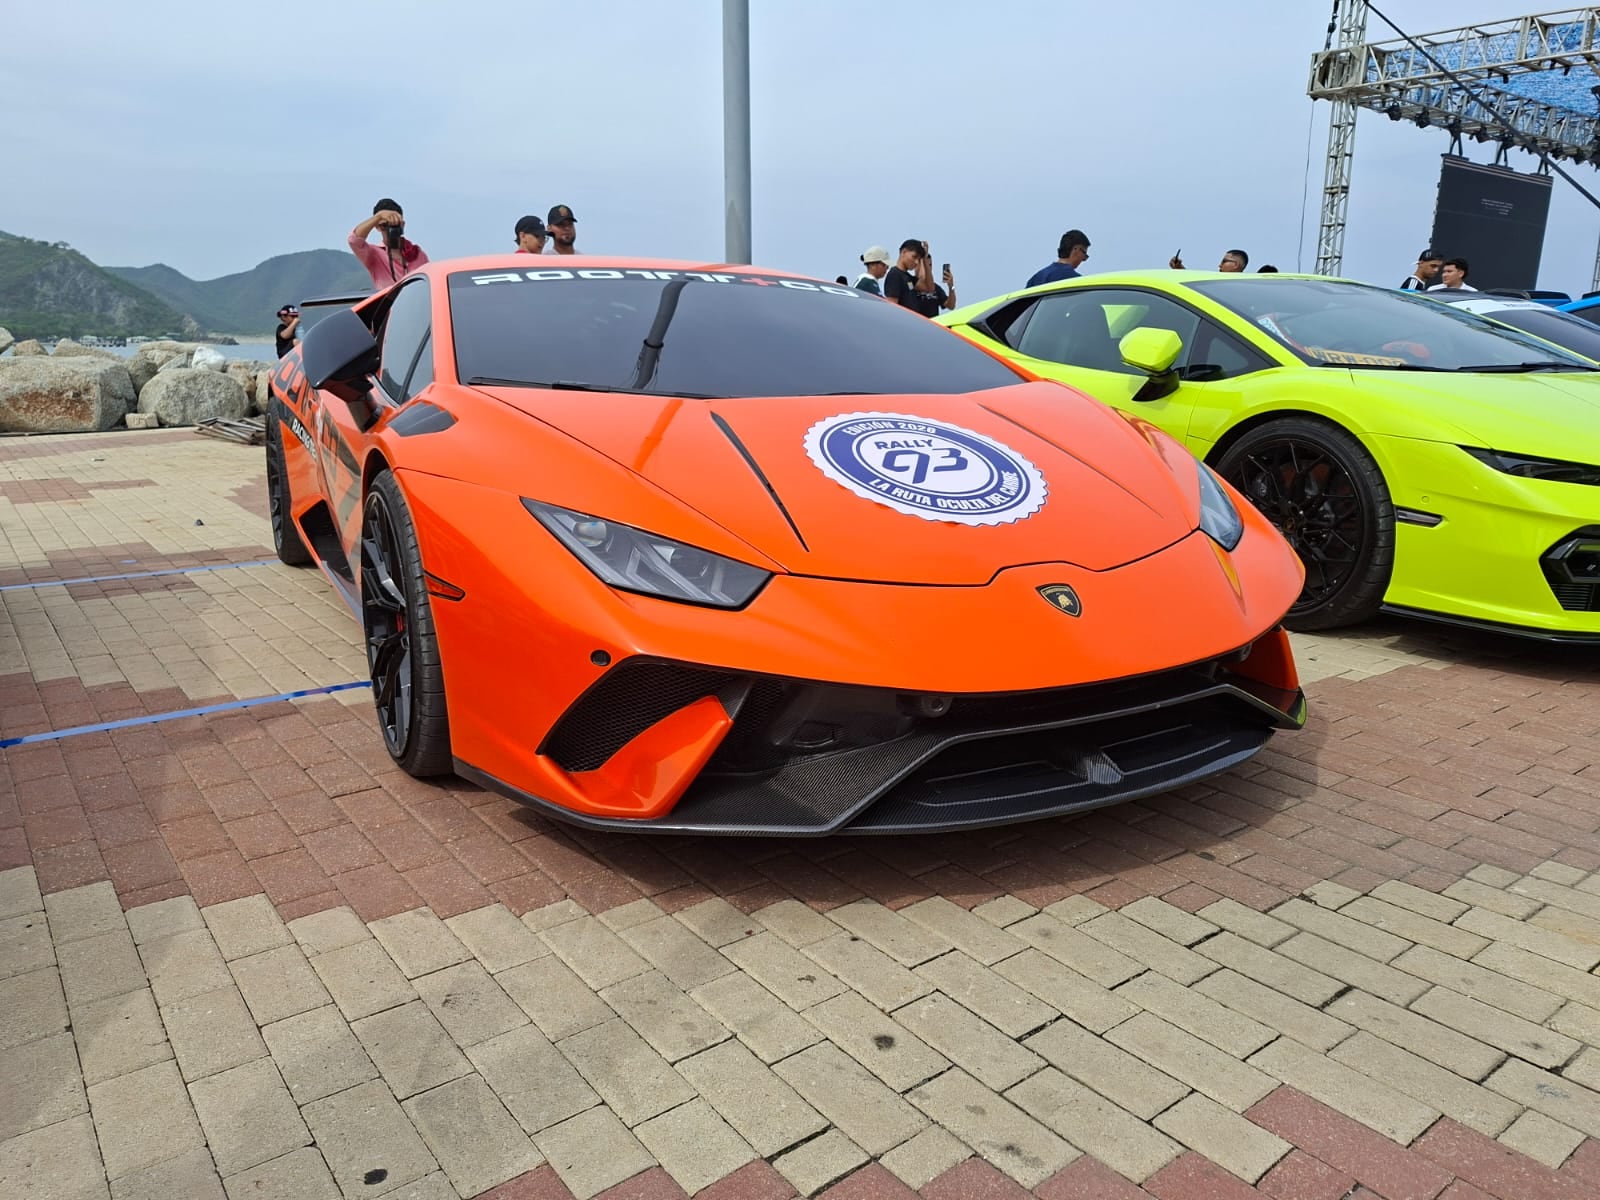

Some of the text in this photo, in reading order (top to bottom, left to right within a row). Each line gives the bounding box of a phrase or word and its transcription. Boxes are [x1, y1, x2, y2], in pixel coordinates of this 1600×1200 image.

[842, 420, 895, 436] EDICIÓN
[874, 438, 934, 451] RALLY
[882, 447, 969, 485] 93
[869, 478, 887, 491] LA
[891, 487, 932, 506] RUTA
[936, 498, 990, 511] OCULTA
[985, 492, 1010, 507] DEL
